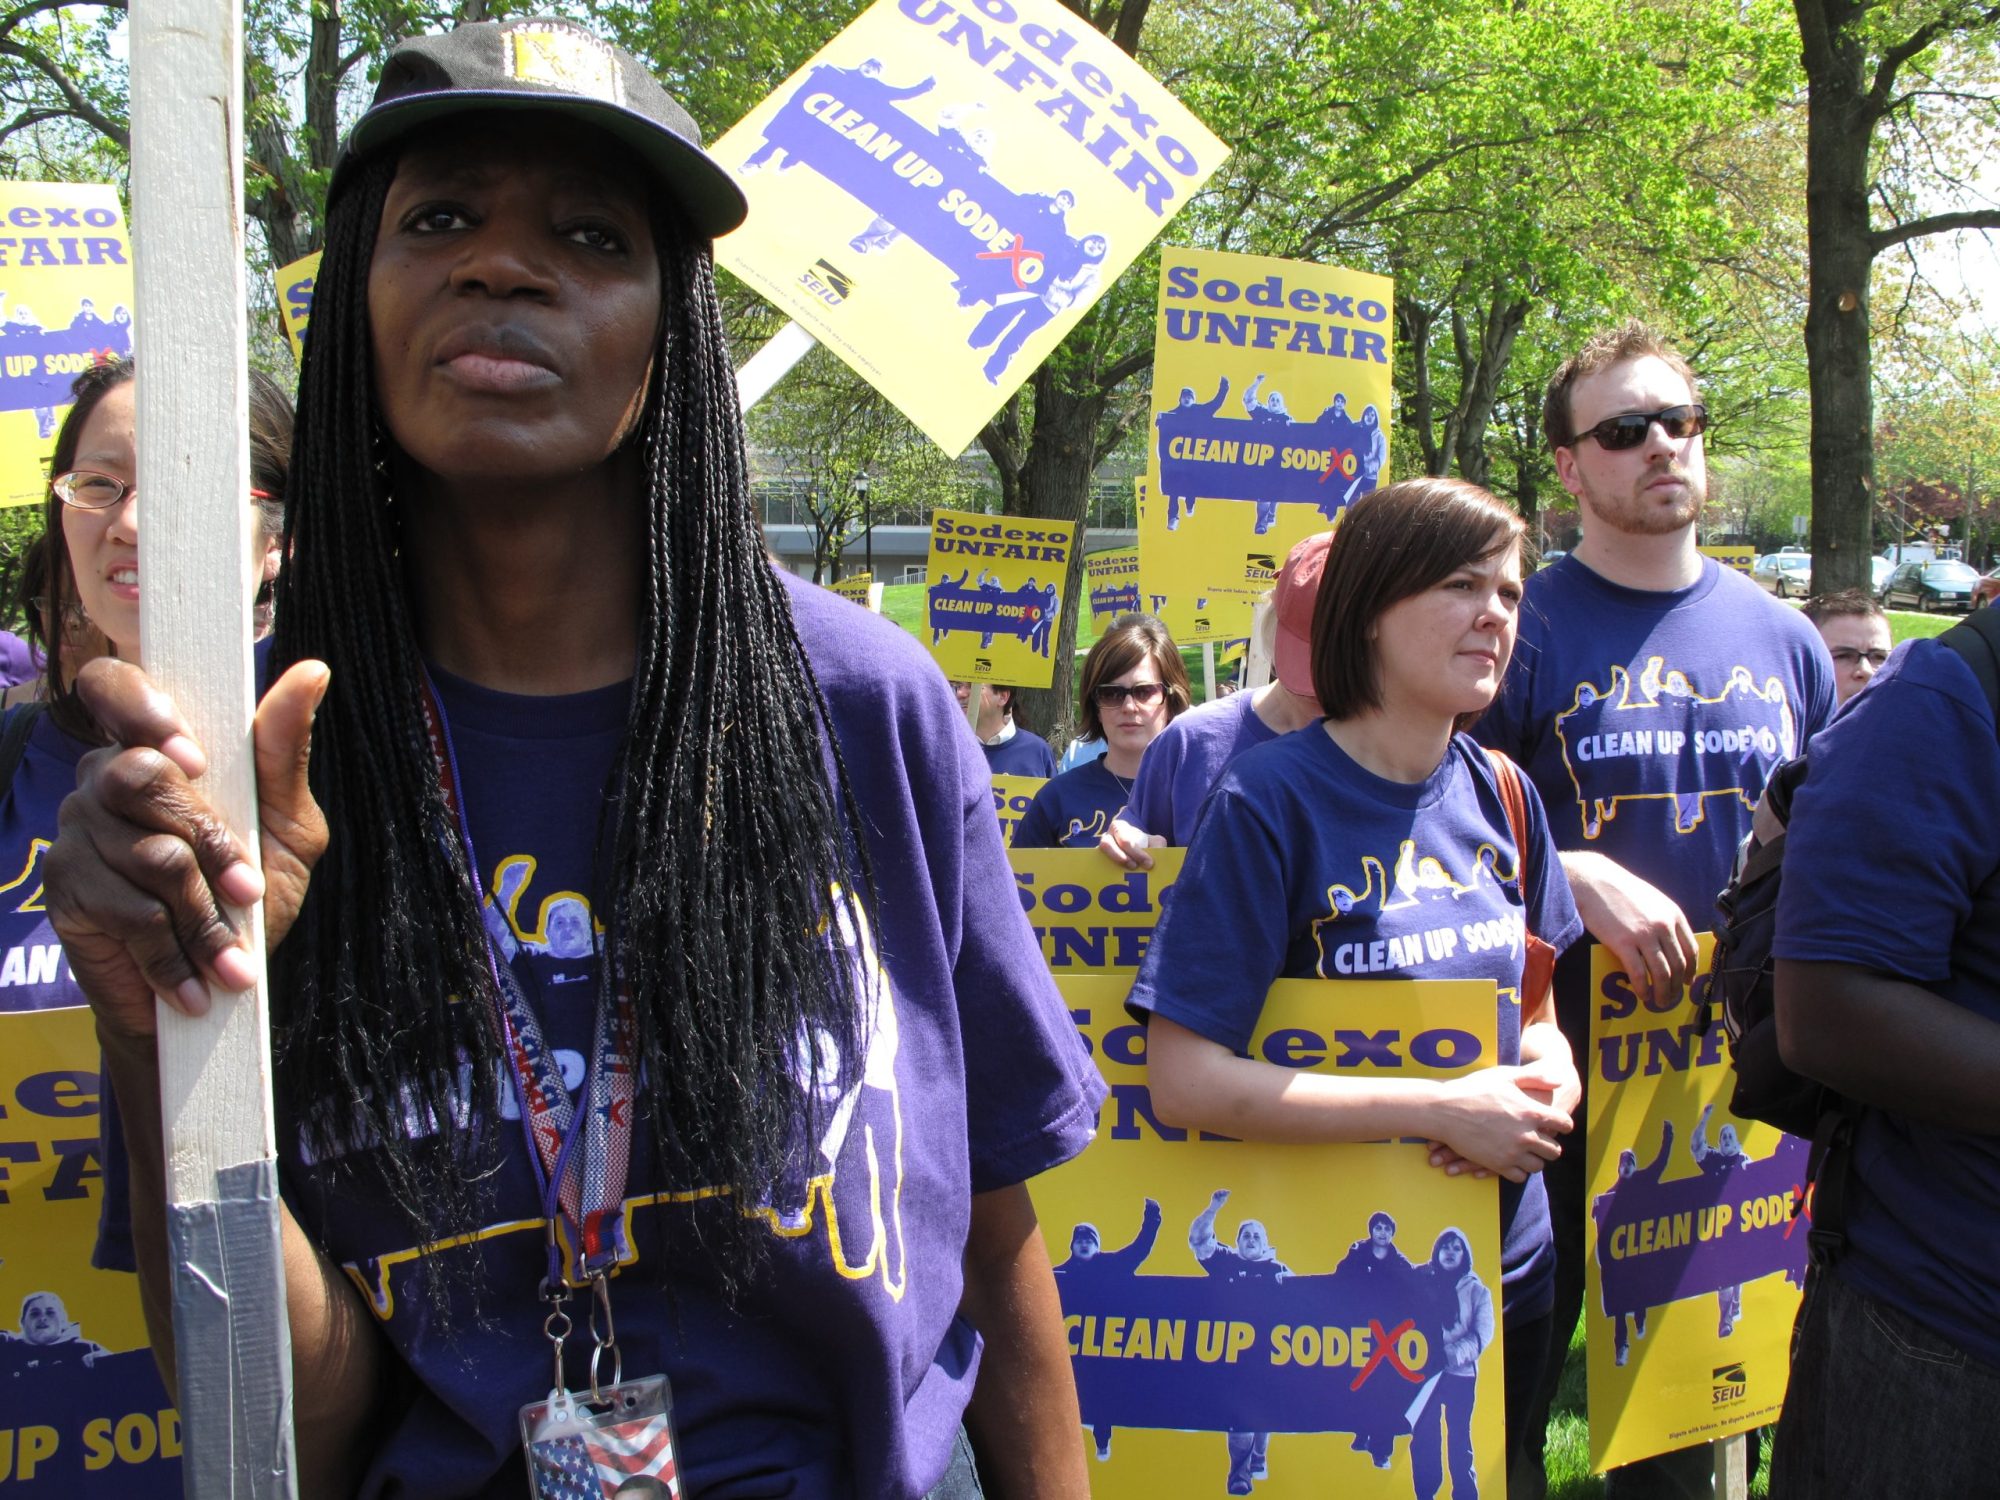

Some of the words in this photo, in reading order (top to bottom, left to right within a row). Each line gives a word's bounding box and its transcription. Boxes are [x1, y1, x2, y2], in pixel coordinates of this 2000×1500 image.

[802, 92, 903, 162] CLEAN
[892, 150, 944, 188] UP
[937, 188, 1045, 290] SODEXO
[0, 206, 118, 228] exo
[797, 273, 843, 306] SEIU
[1166, 266, 1388, 323] Sodexo
[1164, 307, 1388, 365] UNFAIR
[5, 354, 38, 378] UP
[1168, 436, 1240, 465] CLEAN
[1242, 442, 1275, 467] UP
[1280, 446, 1358, 484] SODEXO
[936, 518, 1069, 544] Sodexo
[934, 537, 1066, 563] UNFAIR
[1088, 556, 1138, 568] Sodexo
[1088, 564, 1140, 577] UNFAIR
[1245, 568, 1275, 579] SEIU
[934, 598, 973, 614] CLEAN
[975, 601, 993, 615] UP
[996, 604, 1041, 623] SODEXO
[1576, 730, 1653, 762] CLEAN
[1657, 729, 1686, 755] UP
[1693, 725, 1777, 766] SODEXO
[1334, 932, 1424, 975] CLEAN
[1424, 926, 1459, 961] UP
[1609, 1211, 1692, 1261] CLEAN
[1696, 1204, 1733, 1242] UP
[1740, 1182, 1815, 1241] SODEX
[1062, 1314, 1187, 1361] CLEAN
[1195, 1320, 1256, 1364] UP
[1269, 1318, 1429, 1392] SODEXO
[1711, 1383, 1746, 1404] SEIU
